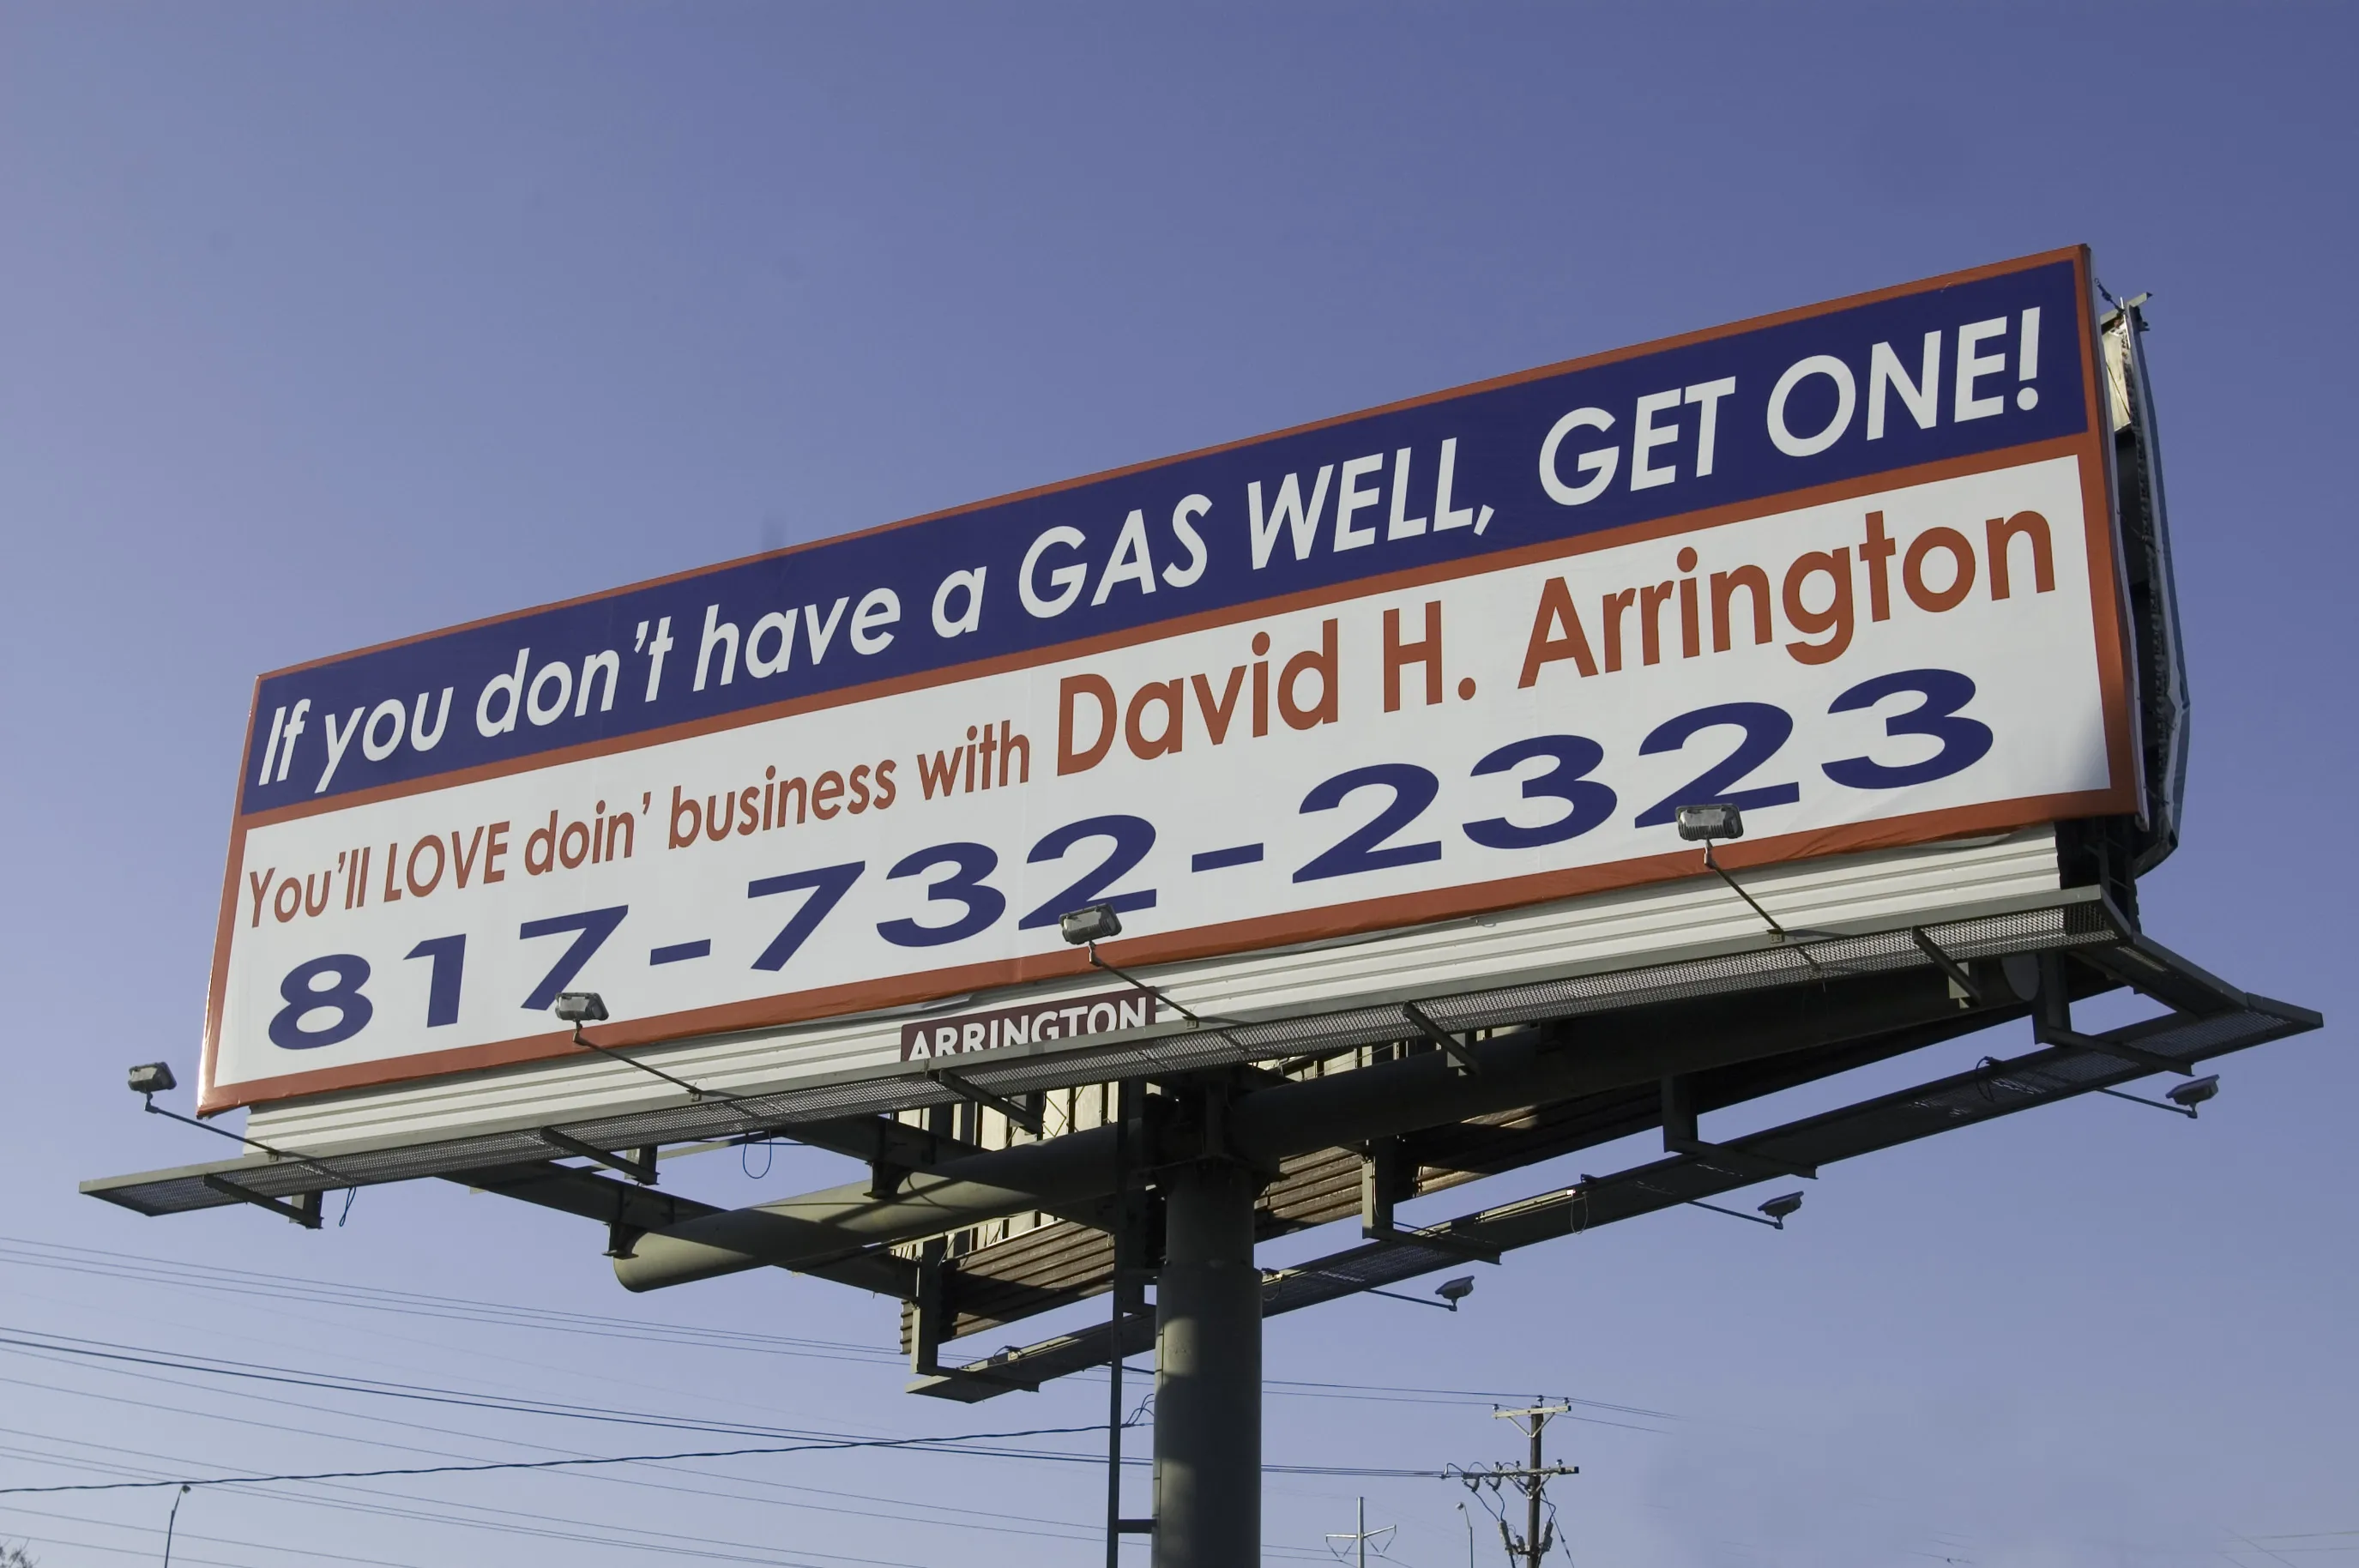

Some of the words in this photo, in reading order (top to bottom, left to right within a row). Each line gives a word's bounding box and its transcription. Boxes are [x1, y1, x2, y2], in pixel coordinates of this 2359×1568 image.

[249, 847, 369, 928] You'll
[383, 821, 510, 902] LOVE
[524, 792, 651, 876] doin'
[668, 758, 896, 848] business
[917, 720, 1029, 801] with
[1057, 618, 1338, 776] David
[1383, 600, 1475, 713] H.
[1517, 510, 2055, 689] Arrington
[258, 698, 311, 786] If
[314, 686, 454, 793] you
[475, 616, 673, 738] don't
[693, 588, 901, 691] have
[932, 566, 986, 638] a
[1018, 493, 1213, 618] GAS
[1246, 437, 1494, 570] WELL,
[1539, 377, 1735, 506] GET
[1766, 306, 2041, 457] ONE!
[268, 668, 1994, 1050] 817-732-2323
[908, 997, 1147, 1061] ARRINGTON
